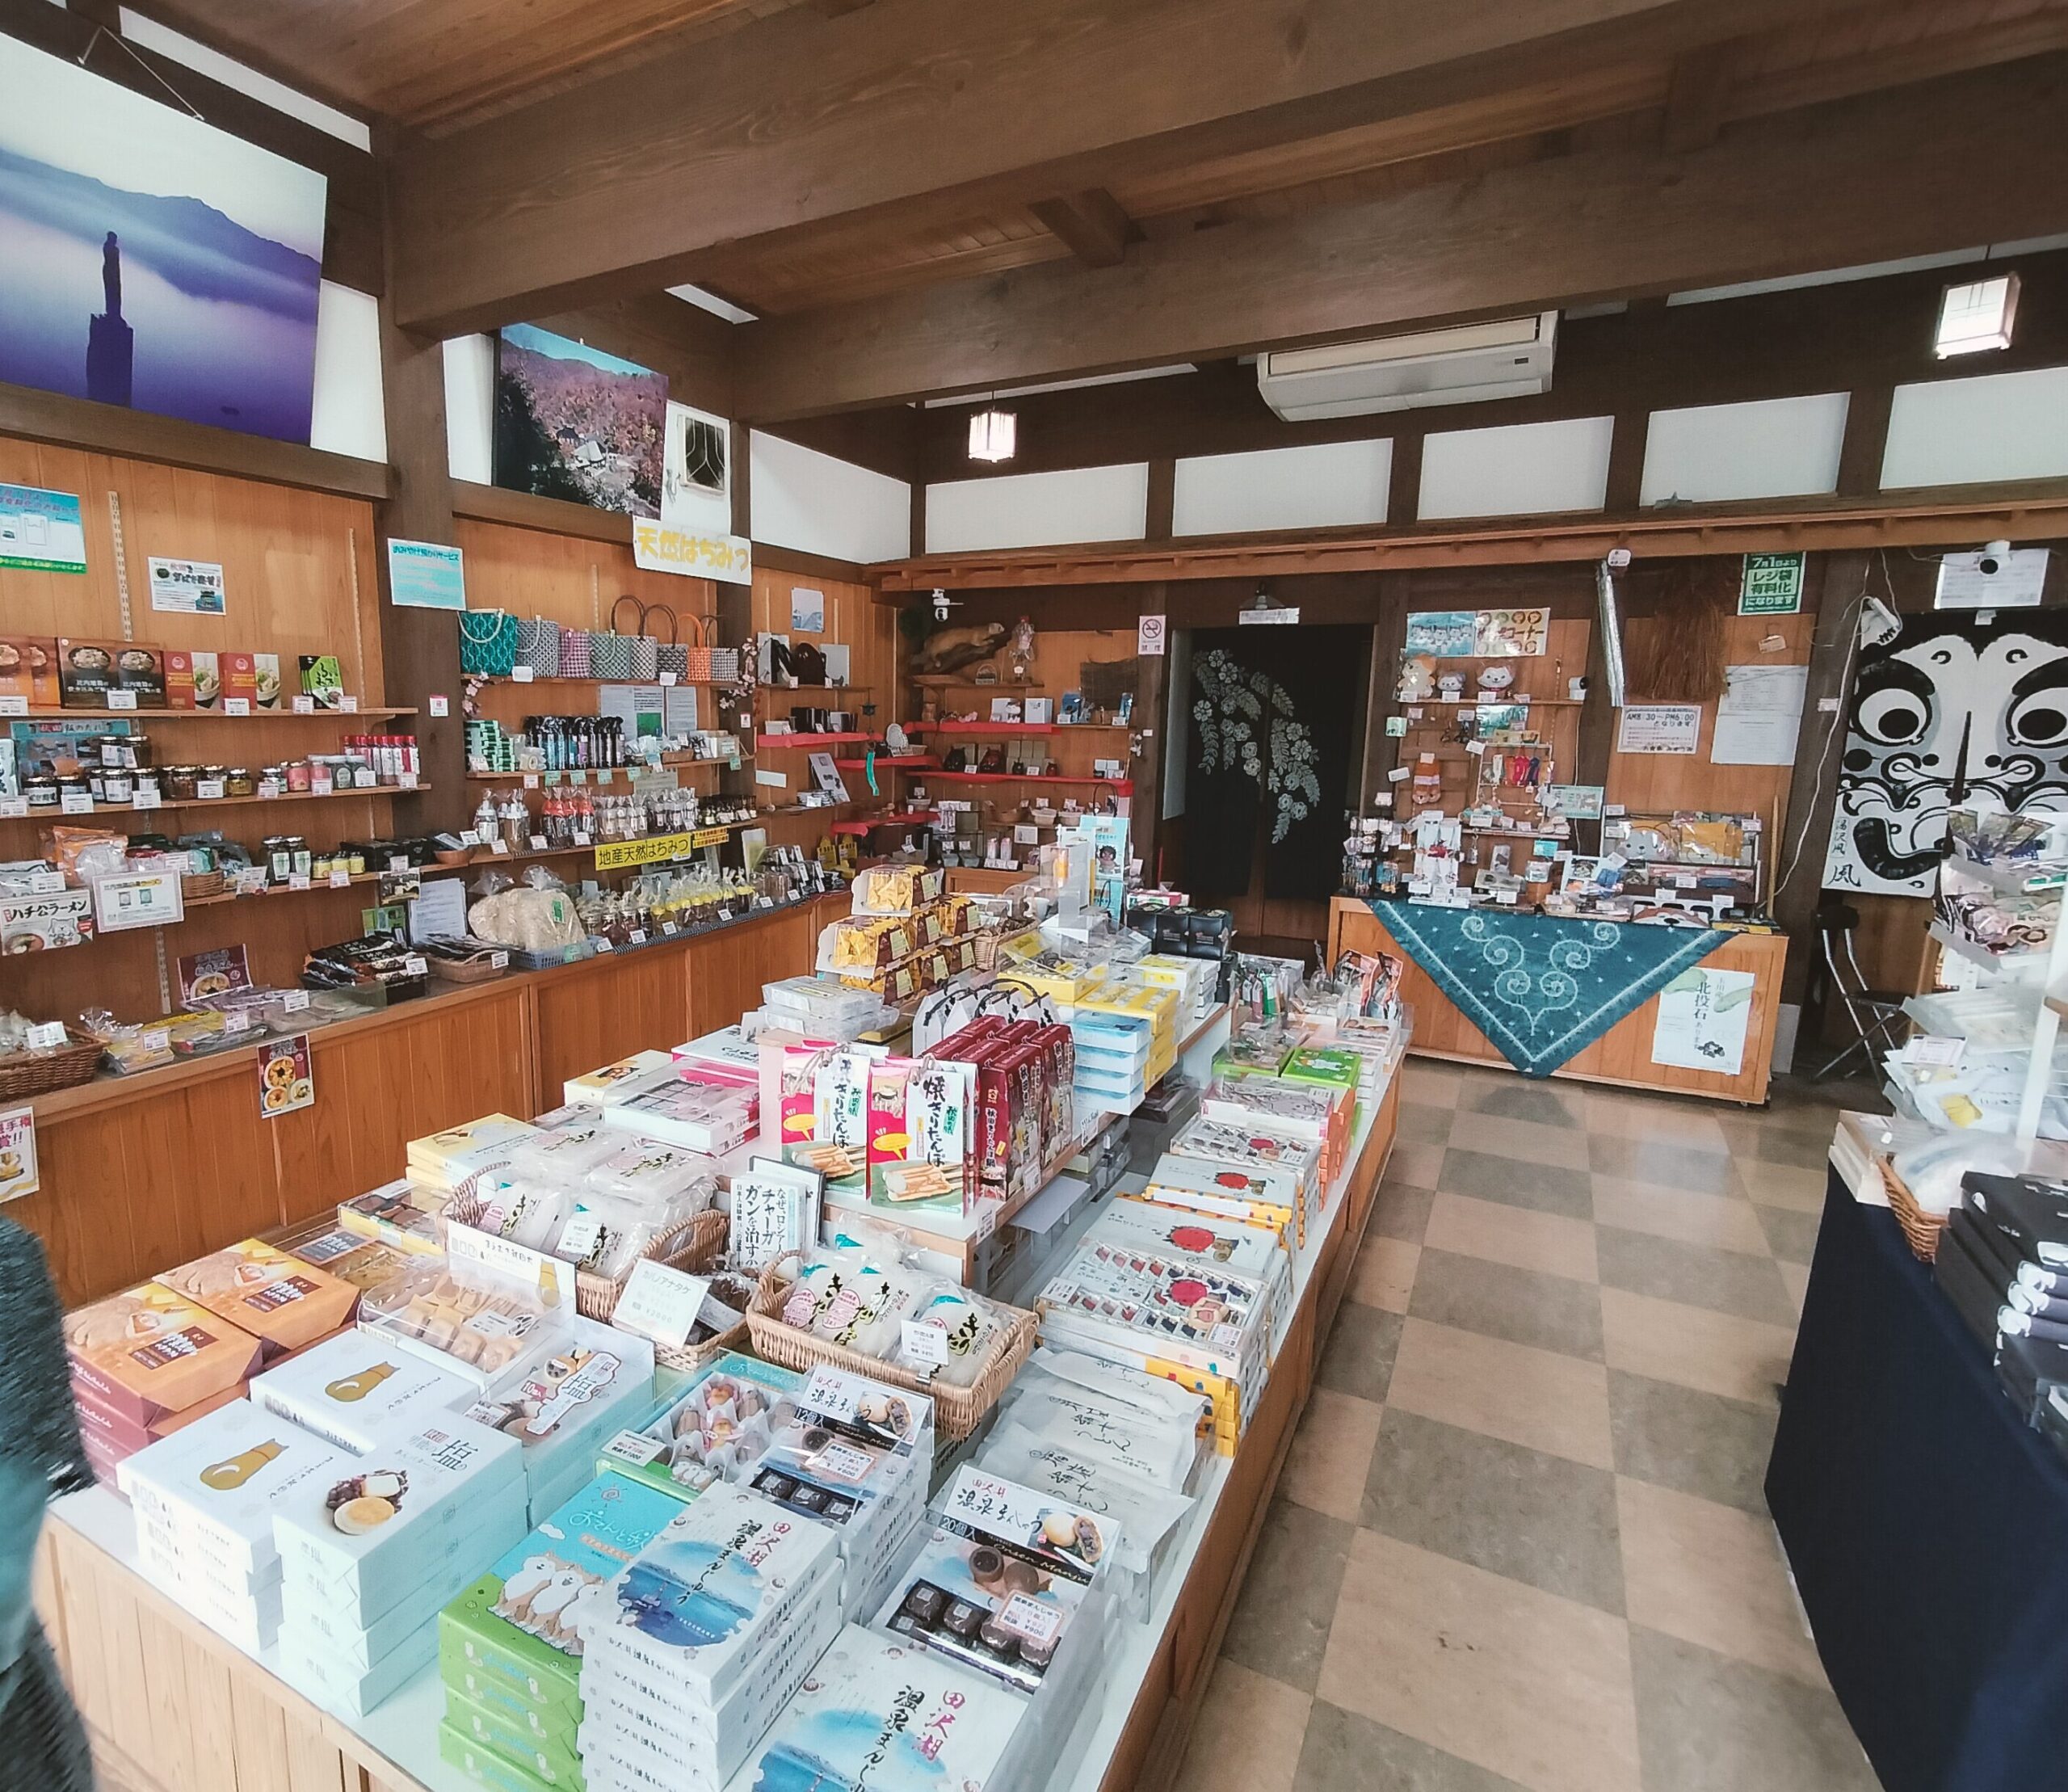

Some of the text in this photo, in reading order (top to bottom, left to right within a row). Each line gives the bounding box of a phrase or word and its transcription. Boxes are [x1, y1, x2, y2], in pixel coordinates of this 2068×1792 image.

[636, 527, 749, 572] 天然はちみつ
[599, 839, 688, 866] 地産天然はちみつ
[11, 900, 87, 919] ハチ公ラーメン
[923, 1075, 947, 1167] 焼きりたんぽ
[940, 1516, 977, 1542] 20個入
[912, 1689, 966, 1762] 田沢湖
